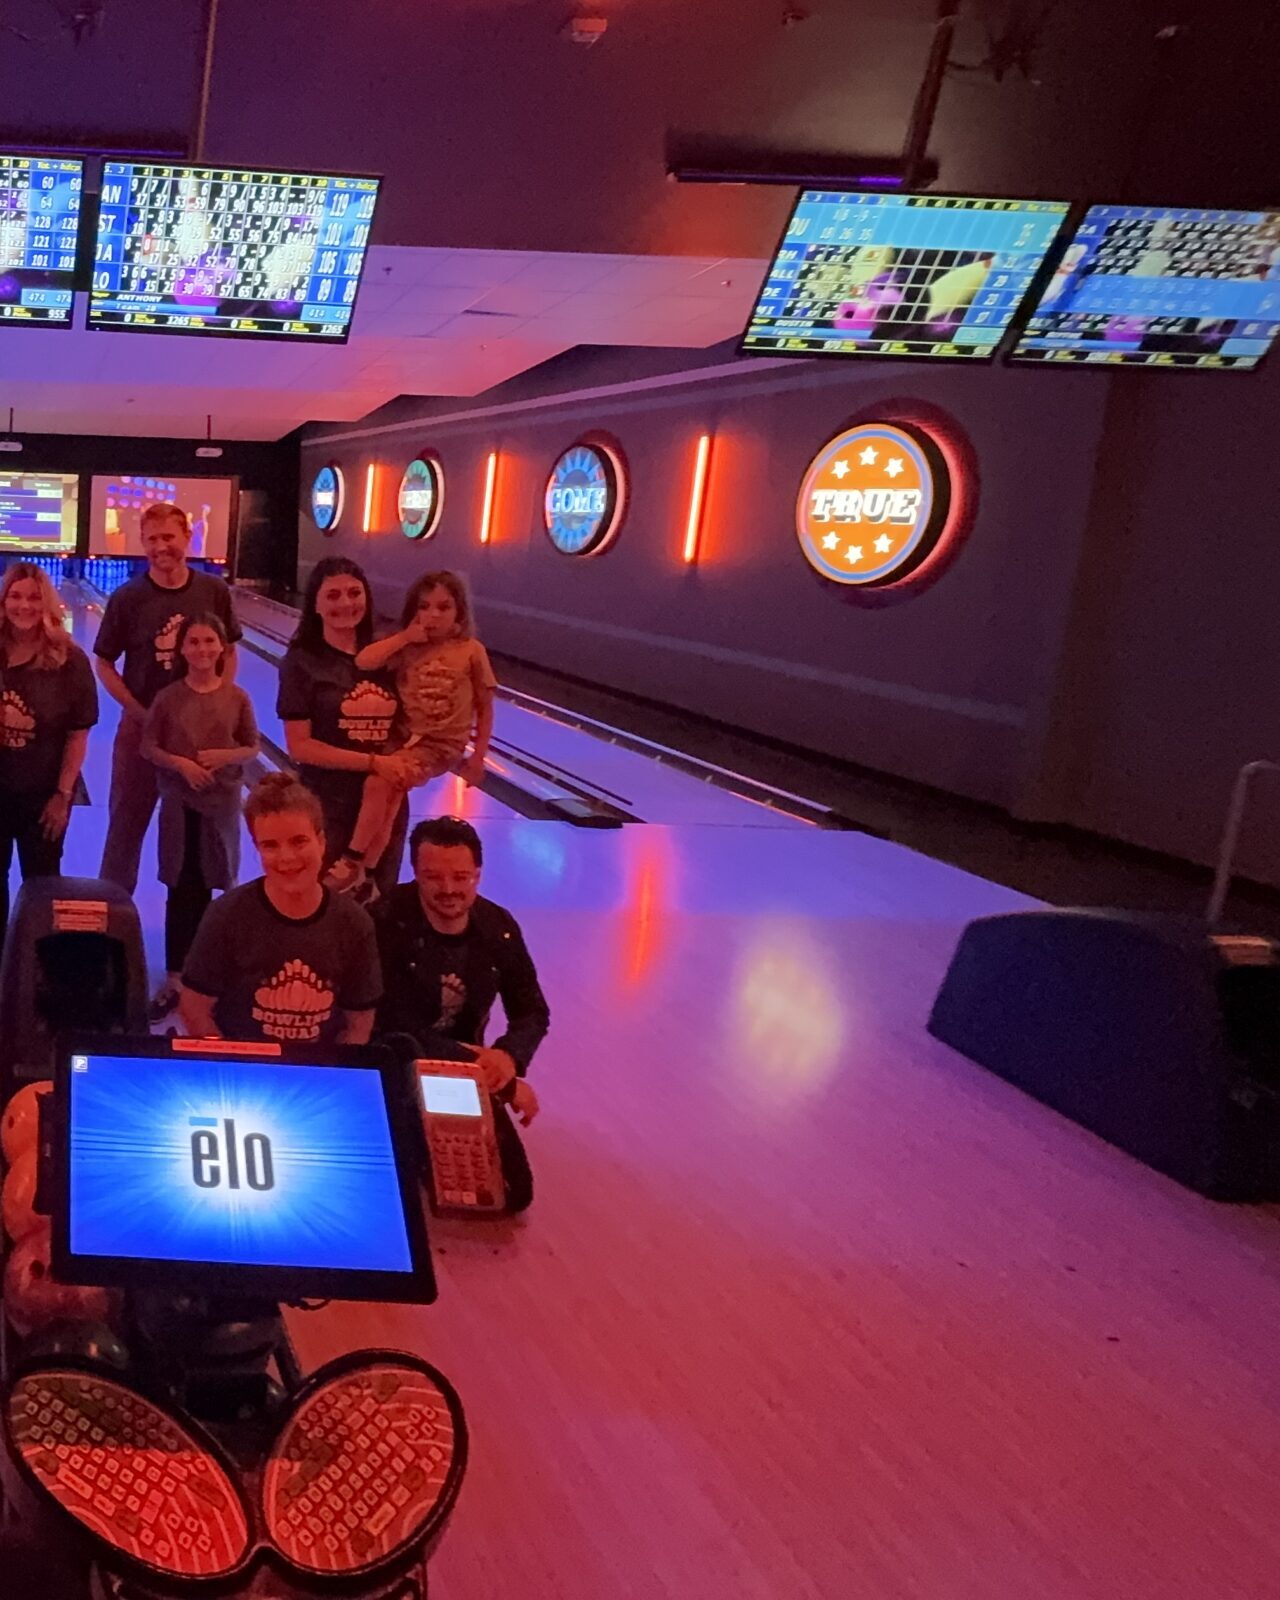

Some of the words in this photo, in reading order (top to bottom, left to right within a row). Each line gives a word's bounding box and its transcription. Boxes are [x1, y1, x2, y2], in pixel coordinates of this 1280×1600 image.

[102, 185, 122, 204] AN
[32, 235, 50, 248] 121
[31, 254, 48, 267] 101
[810, 488, 922, 525] TRUE
[263, 1024, 320, 1040] SQUAD
